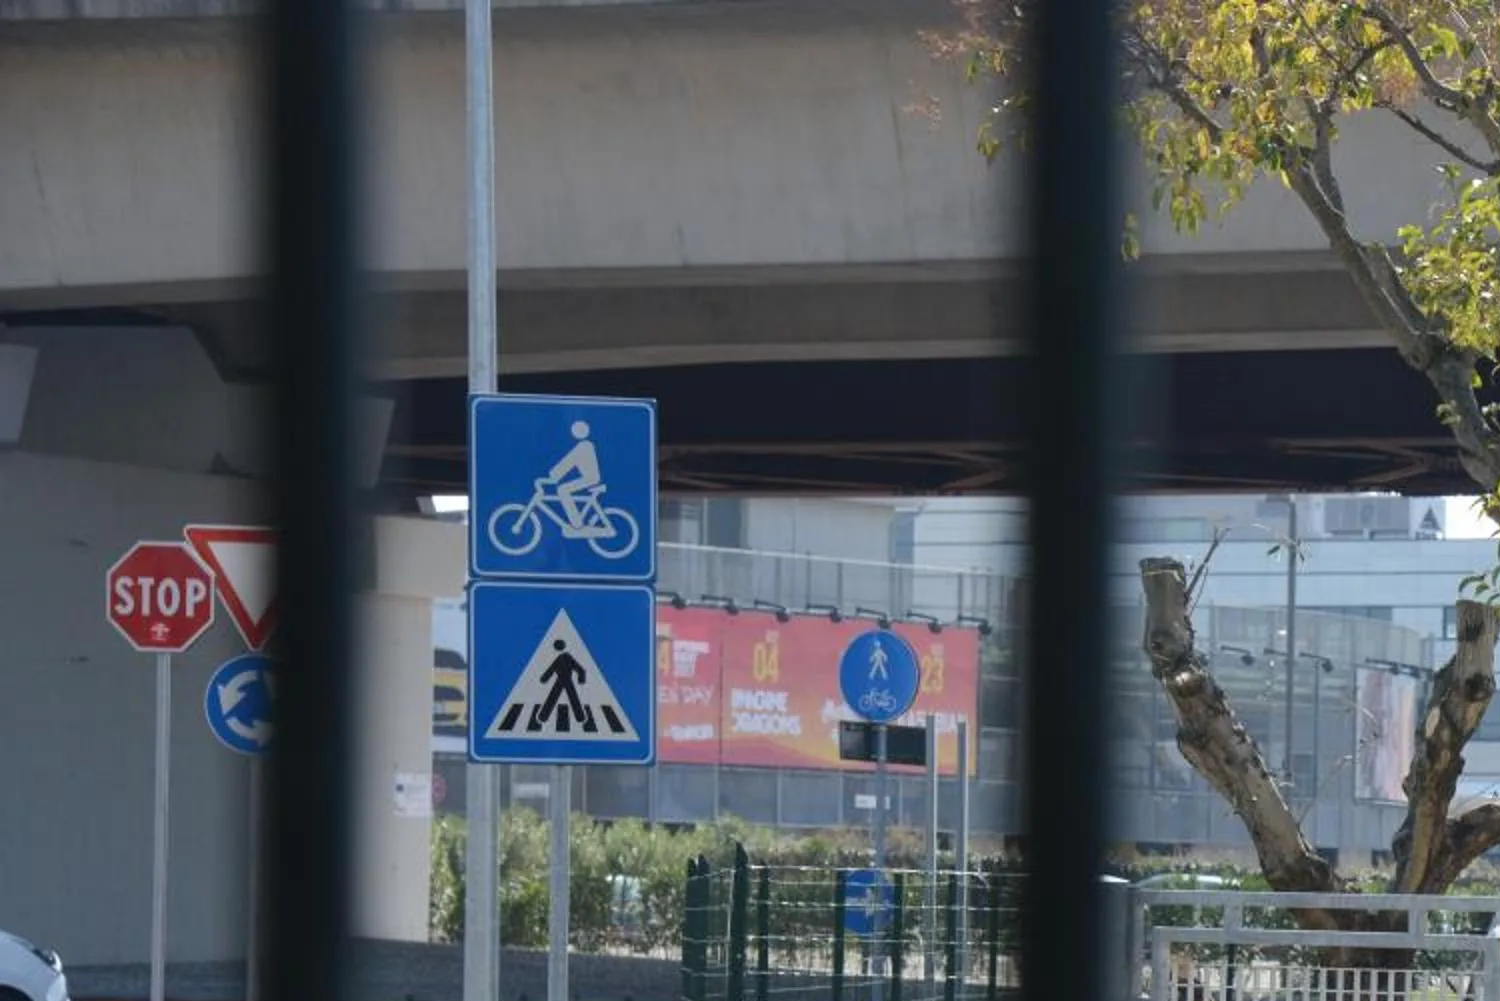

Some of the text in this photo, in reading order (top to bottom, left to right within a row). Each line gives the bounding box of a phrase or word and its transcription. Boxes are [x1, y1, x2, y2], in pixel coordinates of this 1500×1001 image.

[114, 576, 206, 618] STOP
[753, 642, 779, 682] 04
[921, 654, 945, 694] 23
